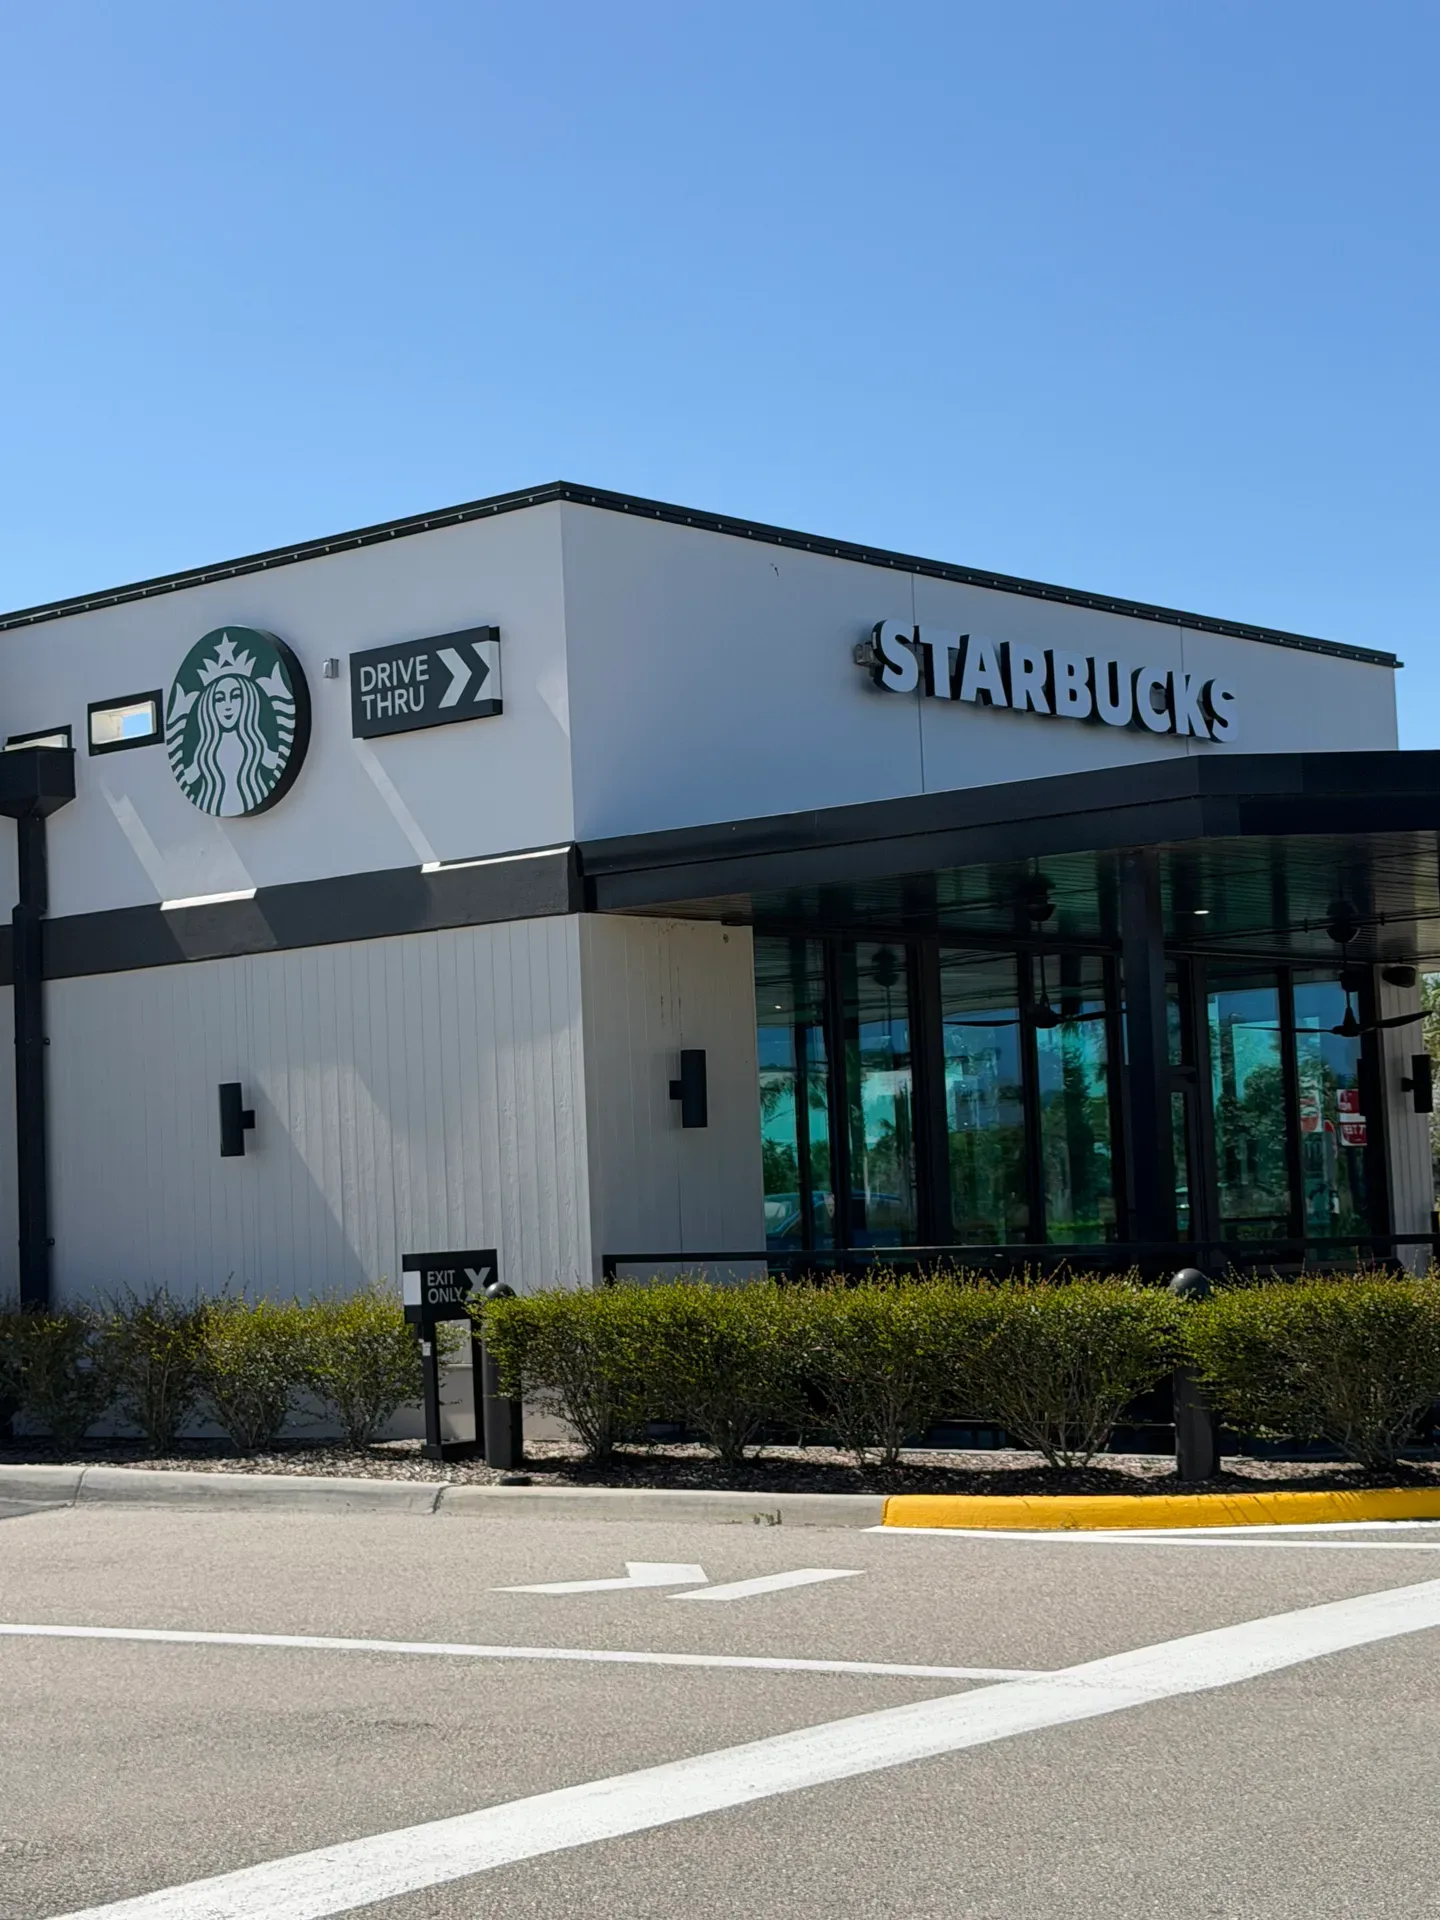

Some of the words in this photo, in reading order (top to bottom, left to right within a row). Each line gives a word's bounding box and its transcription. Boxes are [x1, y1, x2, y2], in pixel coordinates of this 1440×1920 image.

[360, 654, 430, 693] DRIVE
[876, 618, 1239, 743] STARBUCKS
[361, 684, 425, 720] THRU
[426, 1269, 456, 1287] EXIT
[427, 1286, 464, 1304] ONLY
